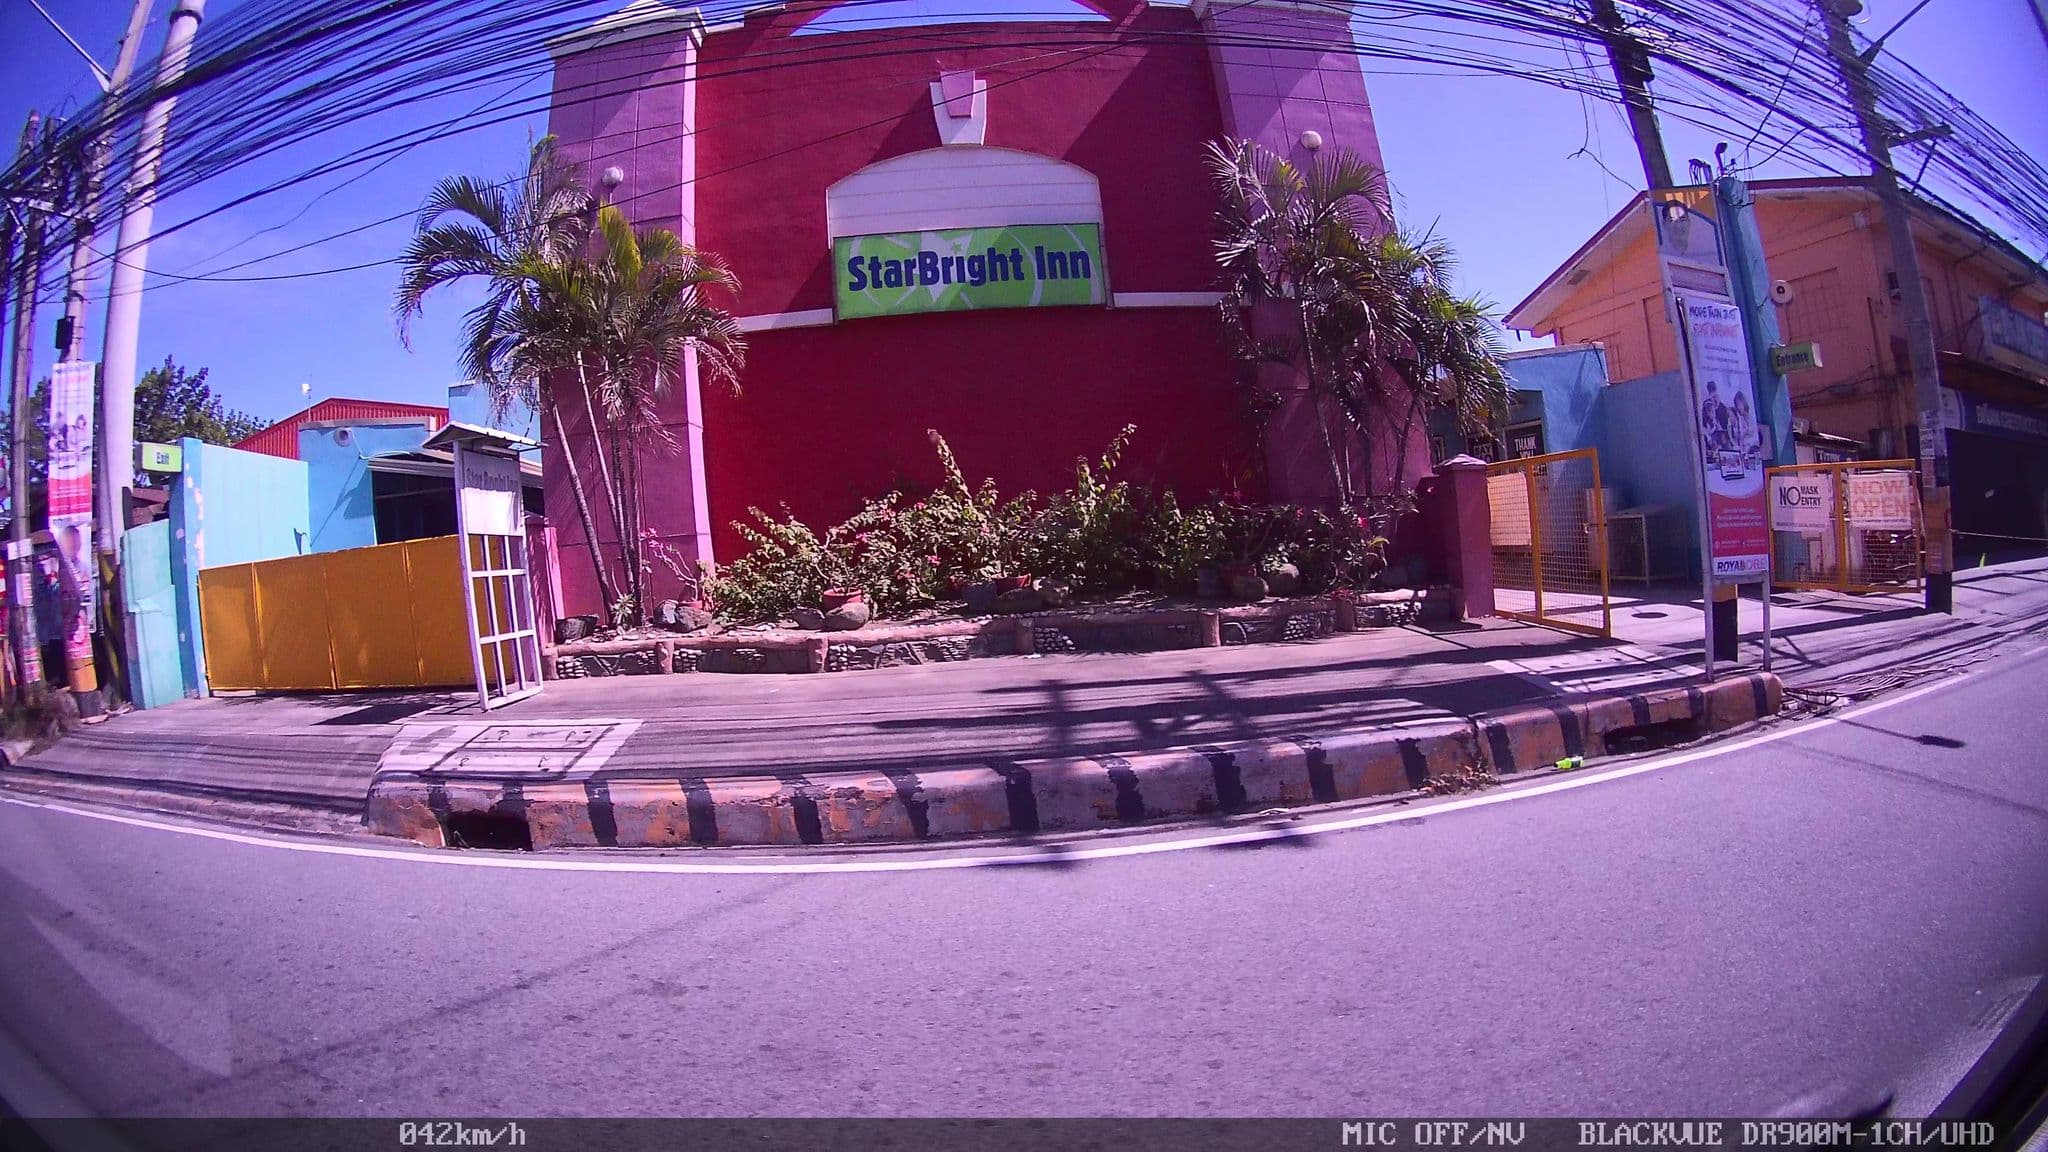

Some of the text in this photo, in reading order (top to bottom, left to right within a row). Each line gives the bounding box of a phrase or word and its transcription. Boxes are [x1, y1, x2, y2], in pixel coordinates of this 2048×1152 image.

[847, 246, 1091, 292] StarBright Inn
[1776, 352, 1809, 367] Entrance
[1514, 436, 1537, 452] THANK
[156, 452, 169, 465] Exit
[1801, 485, 1819, 495] MASK
[1854, 480, 1905, 494] NOW
[1779, 486, 1801, 506] NO
[1801, 496, 1821, 506] ENTRY
[1853, 496, 1908, 517] OPEN
